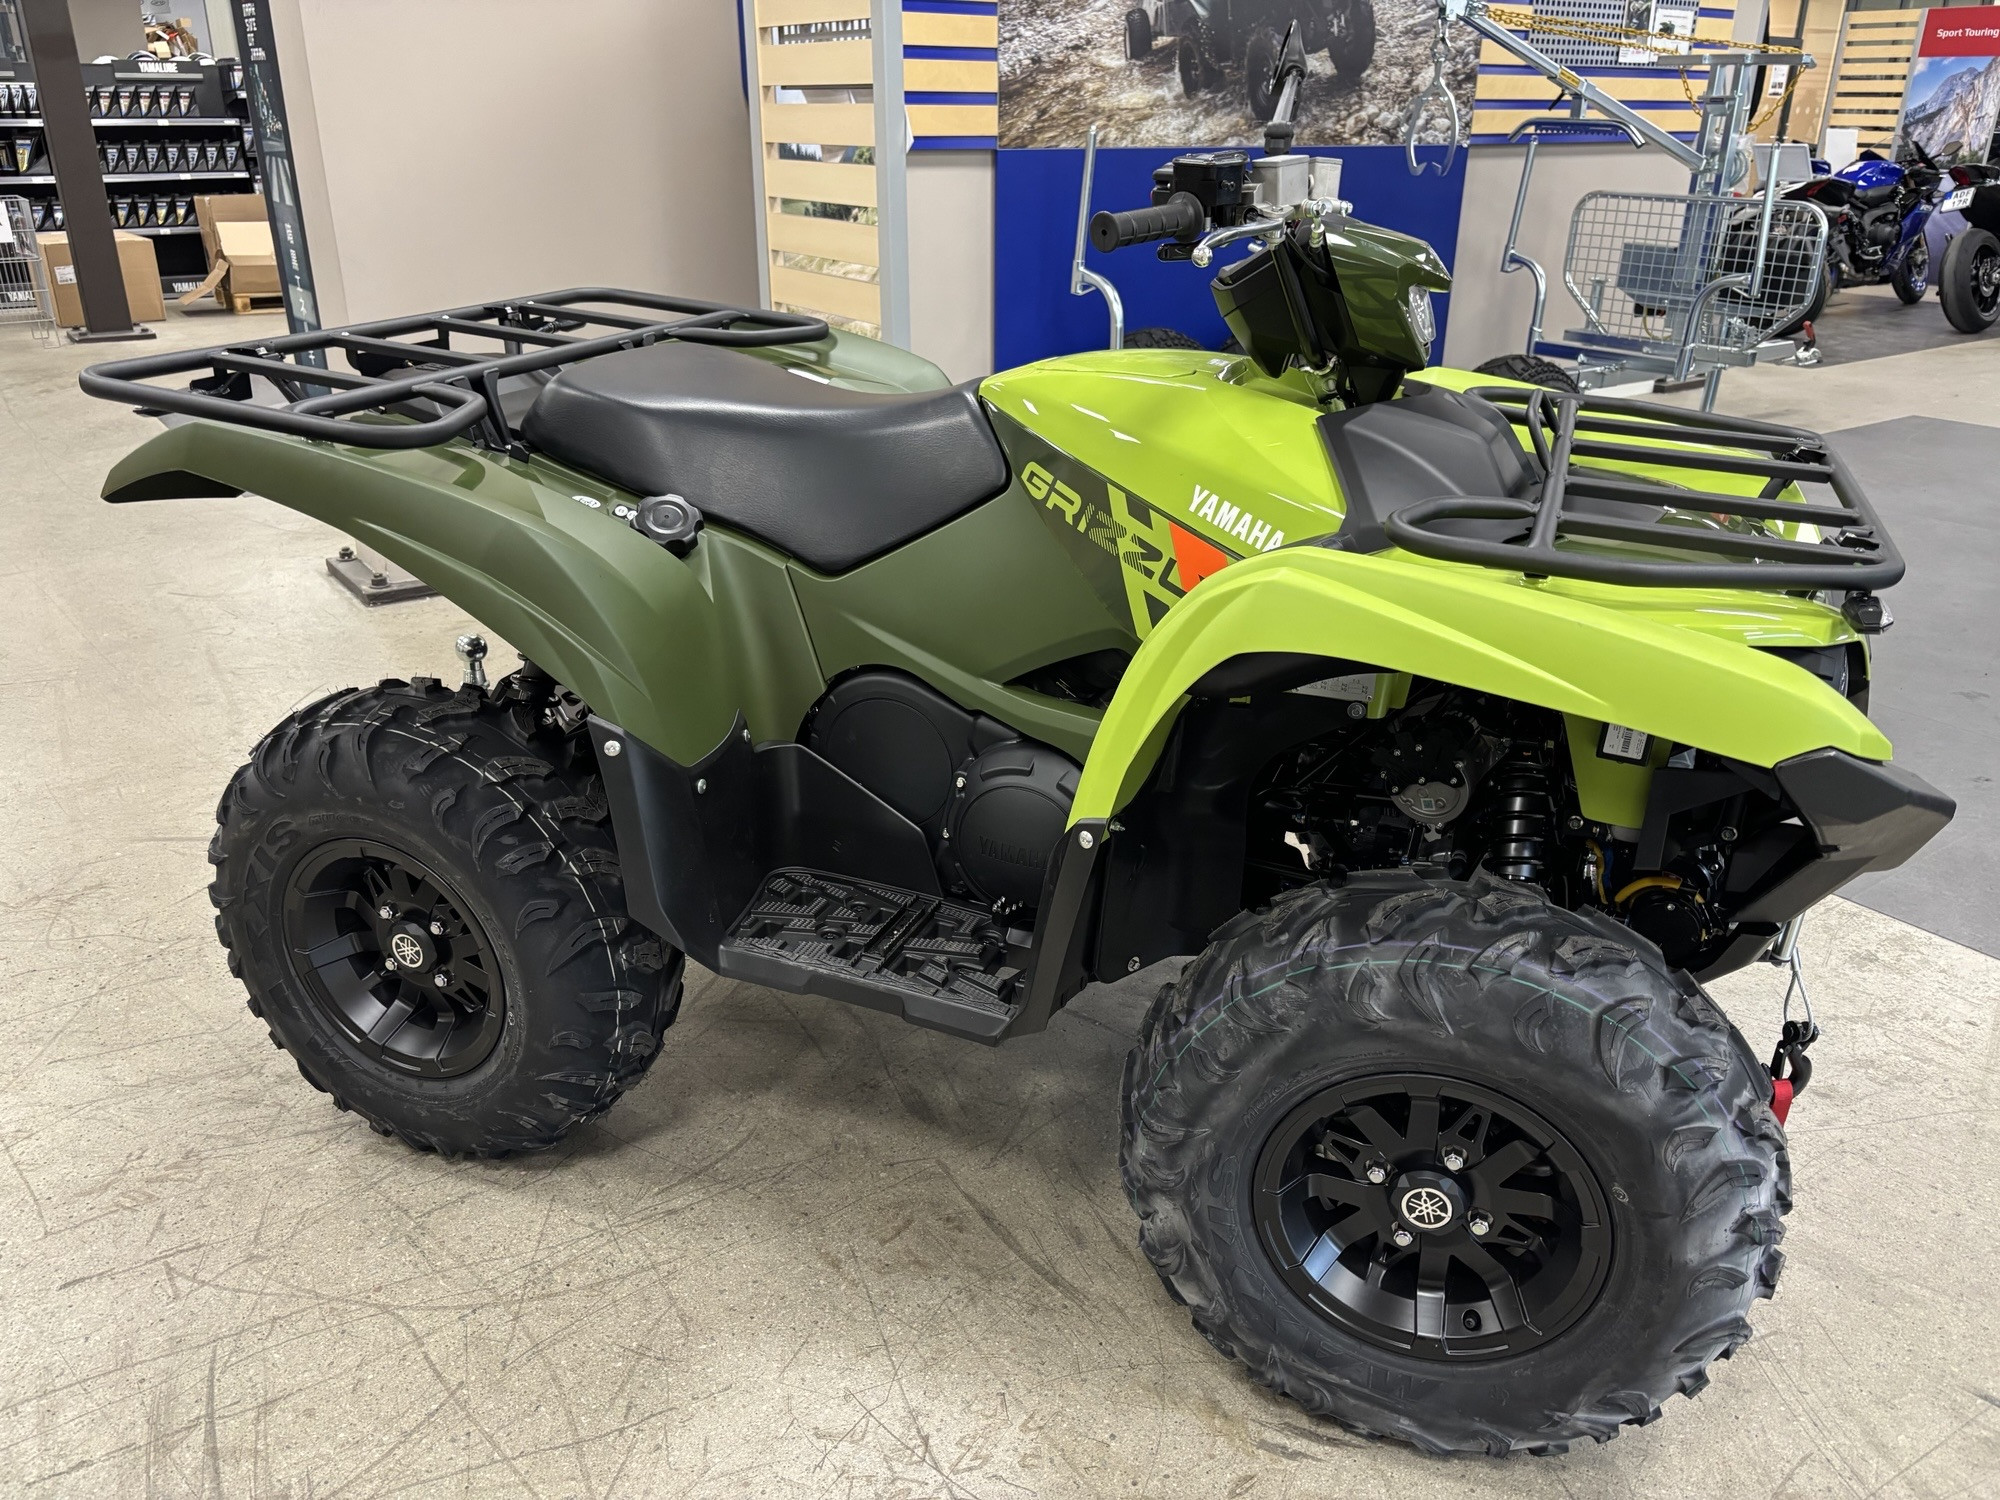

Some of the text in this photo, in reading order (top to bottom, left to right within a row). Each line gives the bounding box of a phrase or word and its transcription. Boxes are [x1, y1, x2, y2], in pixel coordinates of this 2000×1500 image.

[1936, 27, 2000, 39] Sport Touring
[137, 62, 179, 73] YAMALUBE
[1021, 461, 1206, 600] GRIZZL
[1188, 484, 1286, 553] YAMAHA
